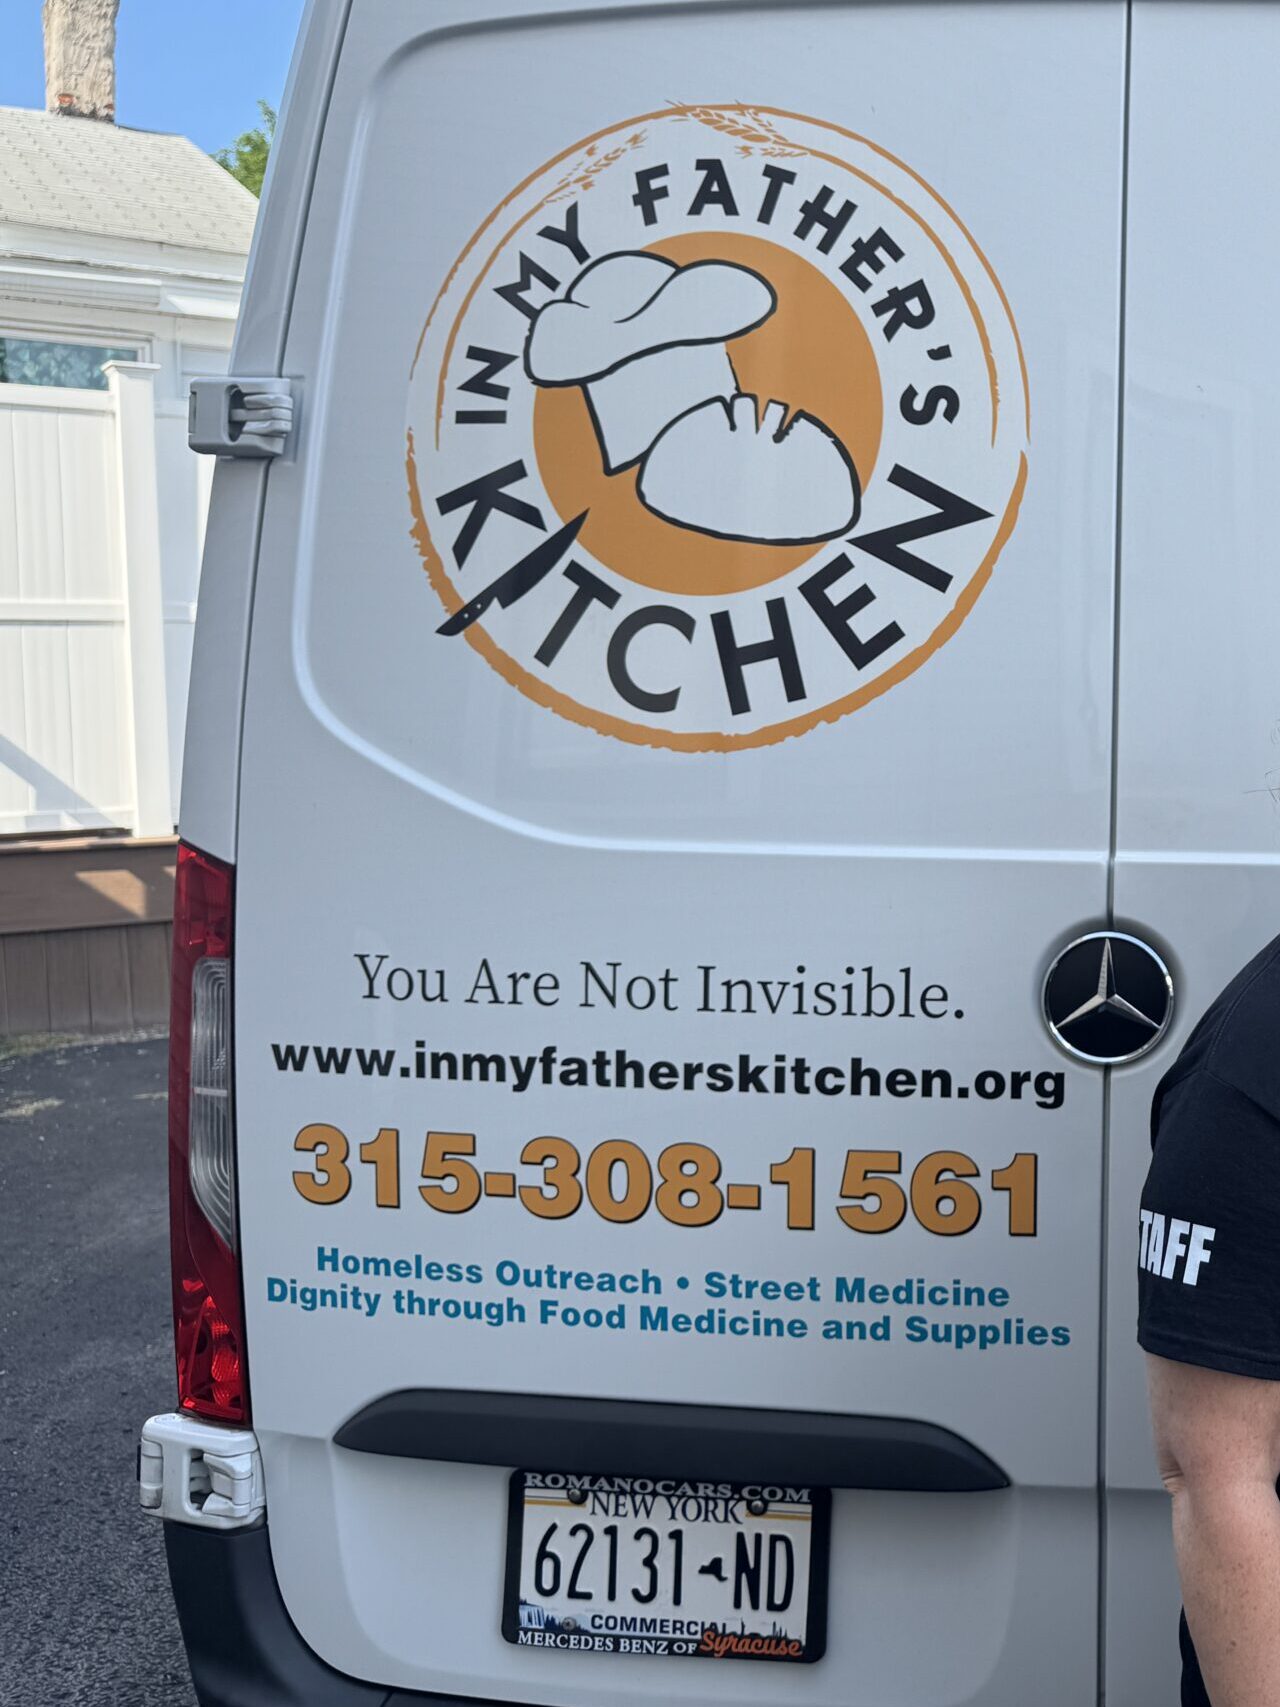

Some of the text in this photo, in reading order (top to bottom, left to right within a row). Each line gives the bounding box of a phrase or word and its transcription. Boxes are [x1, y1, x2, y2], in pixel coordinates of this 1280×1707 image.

[455, 158, 960, 426] IN MY FATHER'S
[434, 458, 995, 716] KITCHEN
[354, 953, 965, 1020] You Are Not Invisible.
[271, 1040, 1066, 1110] www.inmyfatherskitchen.org
[292, 1123, 1038, 1238] 315-308-1561
[316, 1246, 1010, 1307] Homeless Outreach Street Medicine
[1140, 1208, 1217, 1287] TAFF
[267, 1277, 1071, 1350] Dignity through Food Medicine and Supplies
[524, 1472, 811, 1504] ROMANOCARS.COM
[589, 1490, 744, 1525] NEW YORK
[533, 1521, 795, 1612] 62131 ND
[517, 1628, 804, 1658] MERCEDES BENZ OF Syracuse
